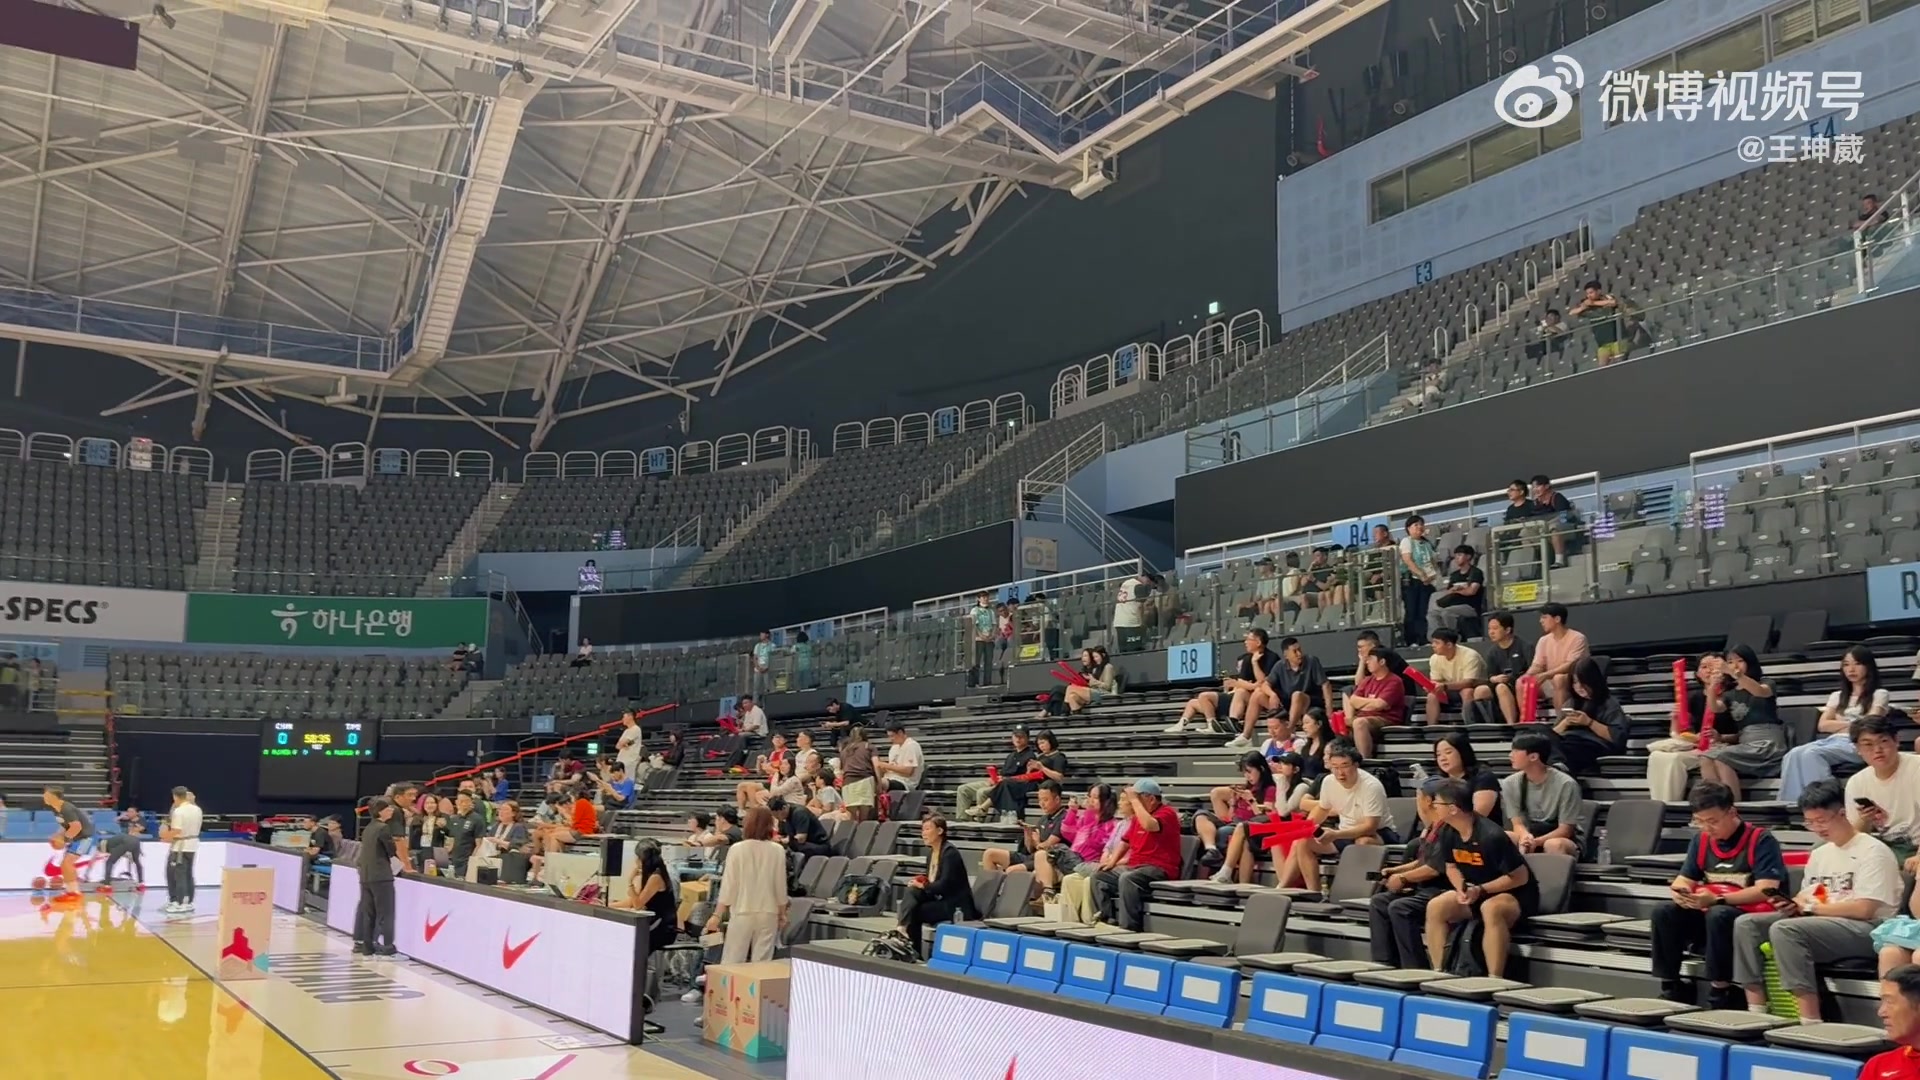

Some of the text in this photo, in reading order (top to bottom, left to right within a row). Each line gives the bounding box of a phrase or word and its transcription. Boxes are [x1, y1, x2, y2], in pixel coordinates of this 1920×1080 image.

[1415, 260, 1433, 285] E3
[650, 452, 665, 467] H7
[312, 608, 413, 637] 하나은행
[1180, 648, 1198, 674] R8
